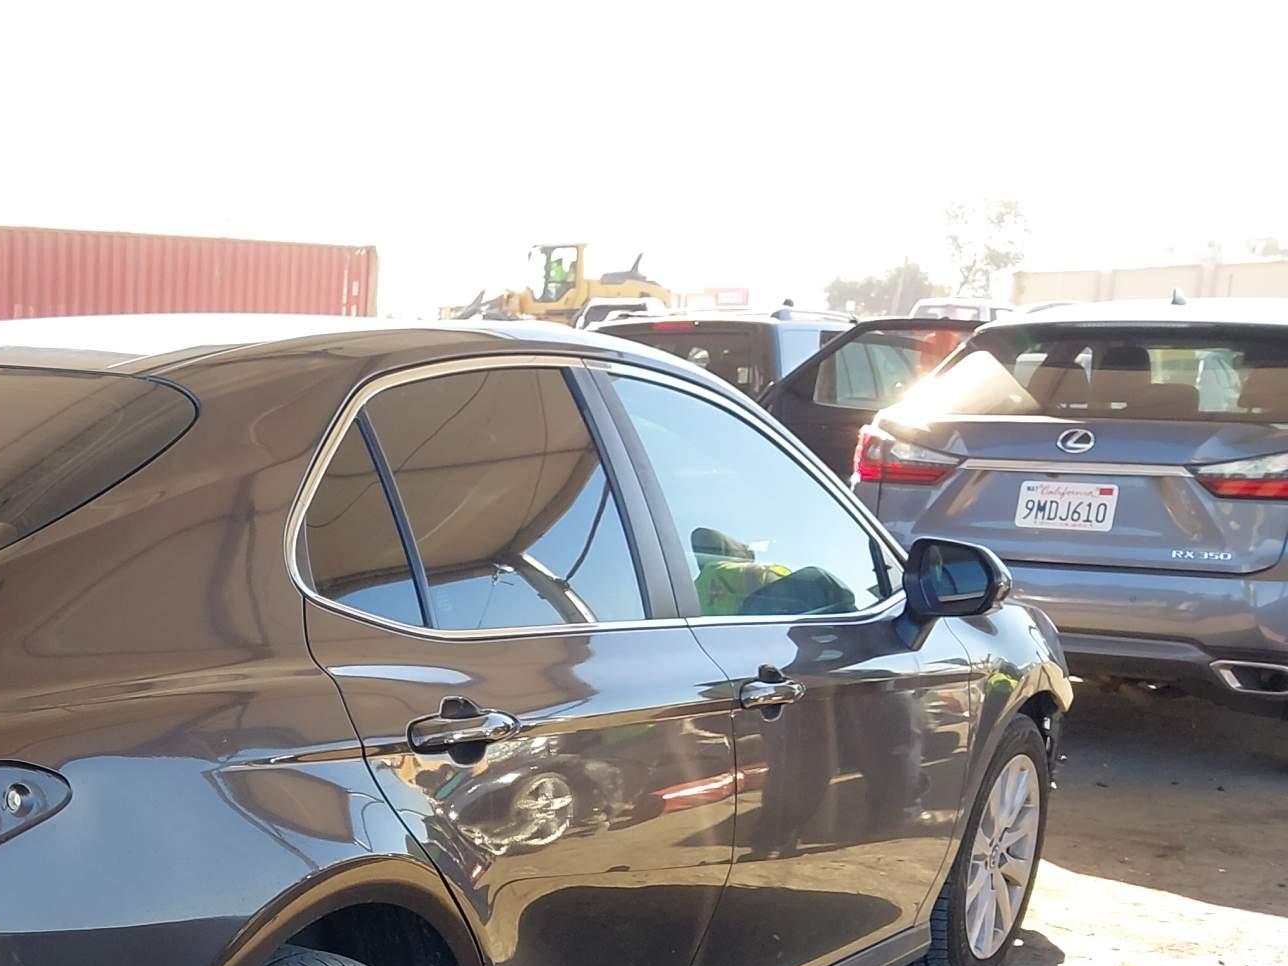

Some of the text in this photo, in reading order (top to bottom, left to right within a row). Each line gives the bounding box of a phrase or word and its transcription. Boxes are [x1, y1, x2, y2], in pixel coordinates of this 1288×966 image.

[1022, 499, 1108, 524] 9MDJ610
[1171, 549, 1232, 560] RX 350
